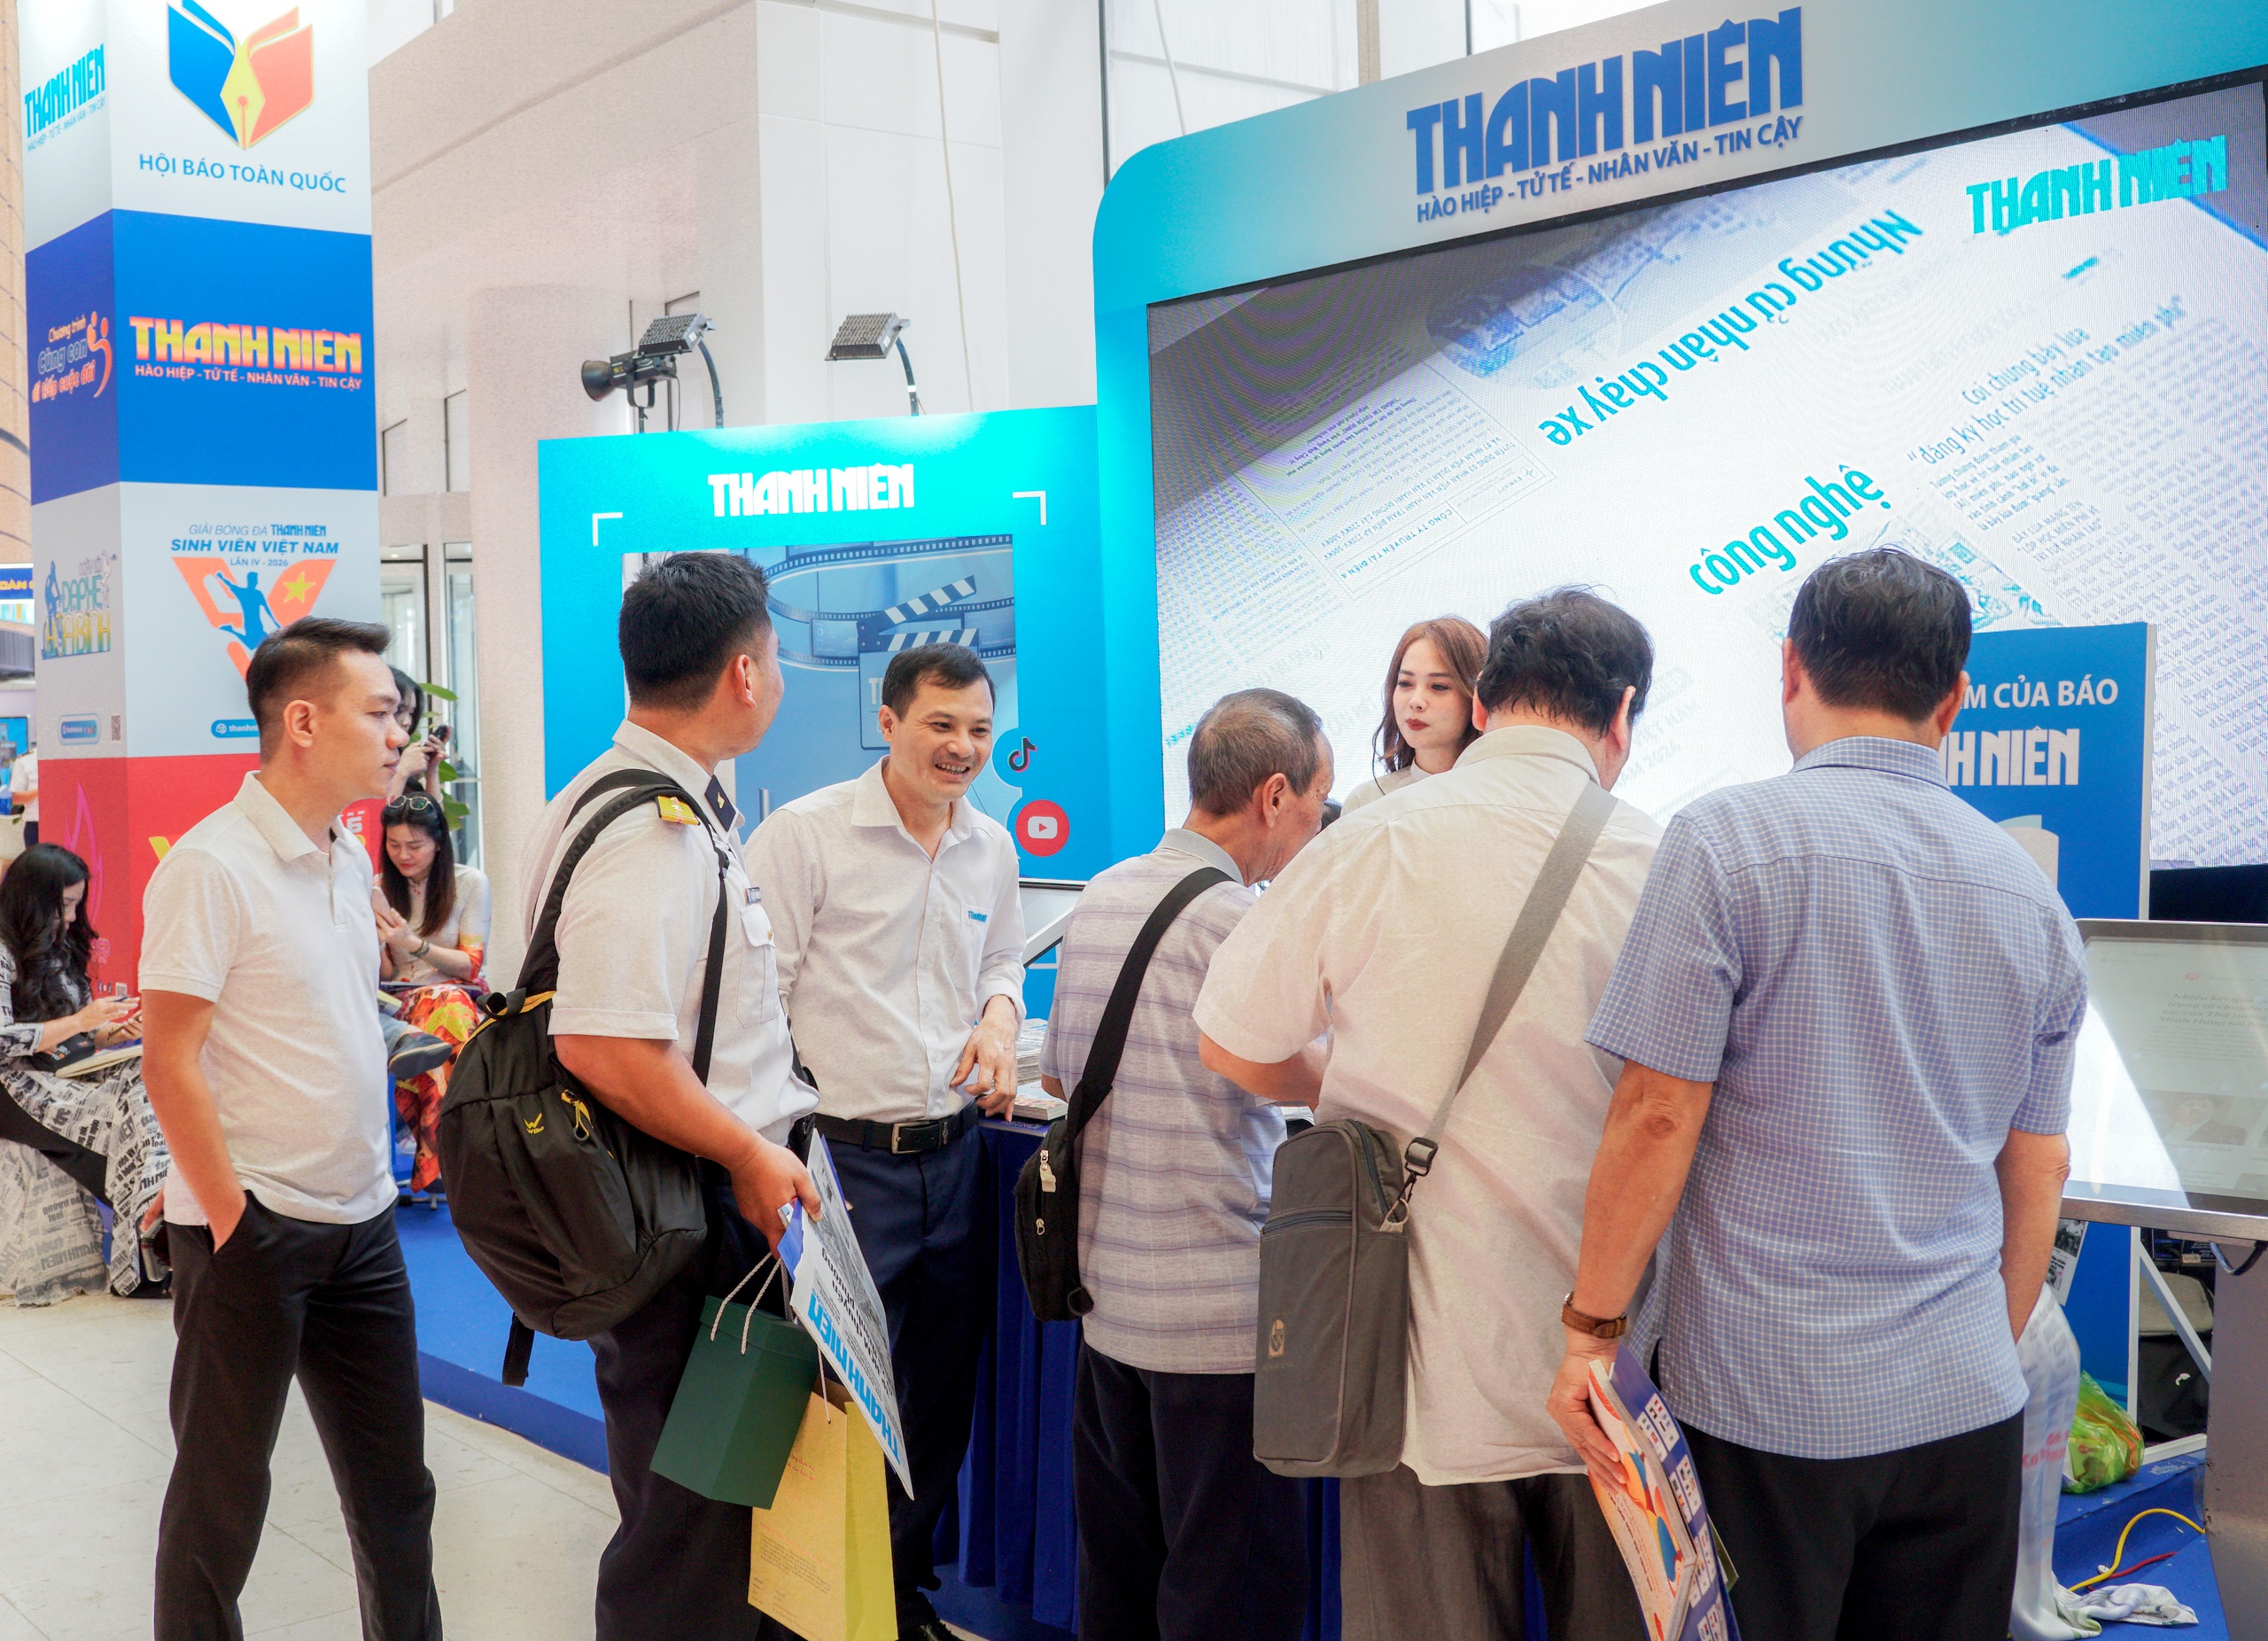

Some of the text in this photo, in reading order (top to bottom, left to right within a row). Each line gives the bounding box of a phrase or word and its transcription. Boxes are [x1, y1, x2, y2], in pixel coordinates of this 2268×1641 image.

[25, 66, 71, 138] THANH
[1406, 6, 1803, 195] THANH NIÊN
[139, 153, 346, 193] HỘI BÁO TOÀN QUỐC
[1418, 199, 1456, 222] HÀO
[1461, 183, 1502, 215] HIỆP
[1517, 175, 1541, 199] TỬ
[1549, 160, 1573, 191] TẾ
[1588, 152, 1649, 184] NHÂN
[1652, 138, 1698, 169] VĂN
[1714, 128, 1752, 156] TIN
[1757, 115, 1804, 149] CẬY
[1966, 135, 2228, 237] THANH NIÊN
[38, 338, 88, 375] Cùng con
[129, 316, 362, 374] THANH NIÊN
[1538, 209, 1923, 446] Những cử nhân chạy xe
[135, 364, 164, 377] HÀO
[166, 366, 195, 382] HIỆP
[203, 366, 221, 381] TỬ
[222, 368, 238, 382] TẾ
[247, 370, 284, 385] NHÂN
[285, 372, 309, 386] VĂN
[318, 377, 337, 387] TIN
[340, 377, 362, 392] CẬY
[707, 462, 915, 518] THANH NIÊN
[1774, 464, 1891, 544] nghệ
[171, 538, 339, 556] SINH VIÊN VIỆT NAM
[271, 524, 304, 536] THANH
[305, 525, 327, 537] NIÊN
[1416, 522, 1428, 533] TY
[1993, 674, 2050, 709] CỦA
[2058, 674, 2118, 706] BÁO
[1980, 725, 2080, 786] NIÊN
[808, 1293, 848, 1373] NIÊN
[848, 1357, 902, 1466] THANH
